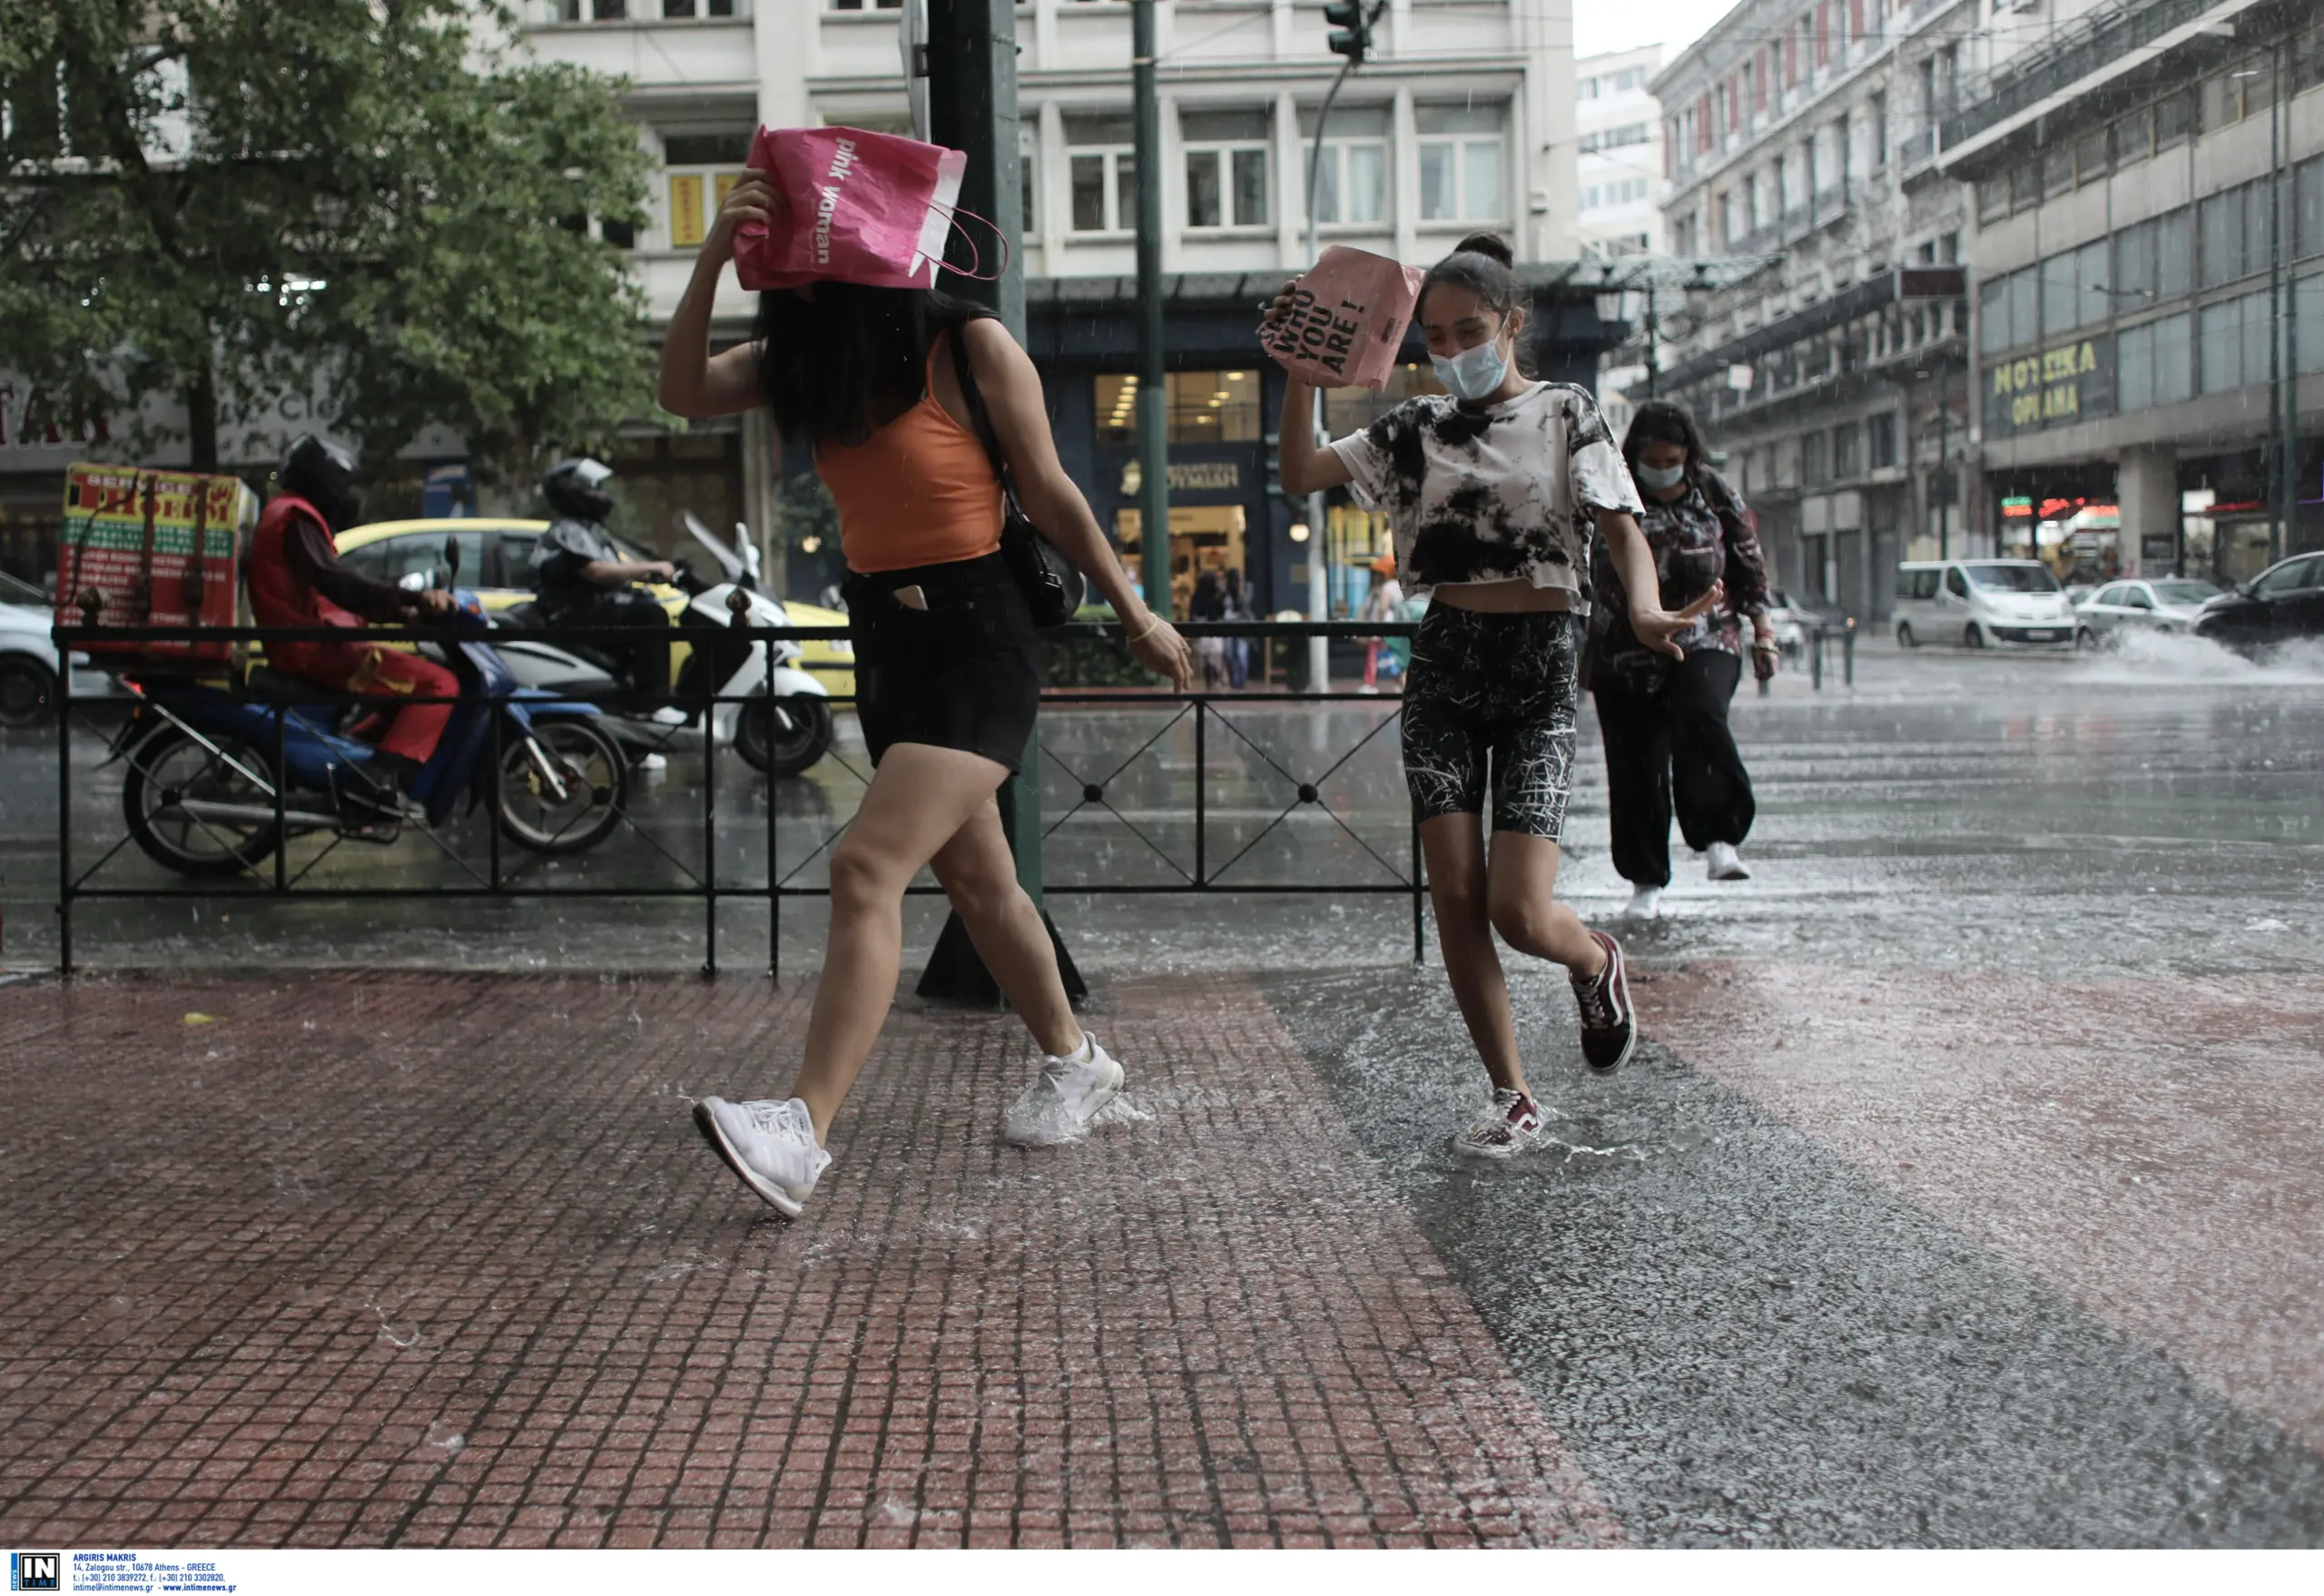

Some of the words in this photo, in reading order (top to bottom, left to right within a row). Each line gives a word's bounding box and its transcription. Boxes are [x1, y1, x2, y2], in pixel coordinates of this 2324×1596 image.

[828, 137, 859, 182] pink
[817, 186, 842, 264] woman
[1273, 290, 1315, 354] WHO
[1295, 305, 1334, 361] YOU
